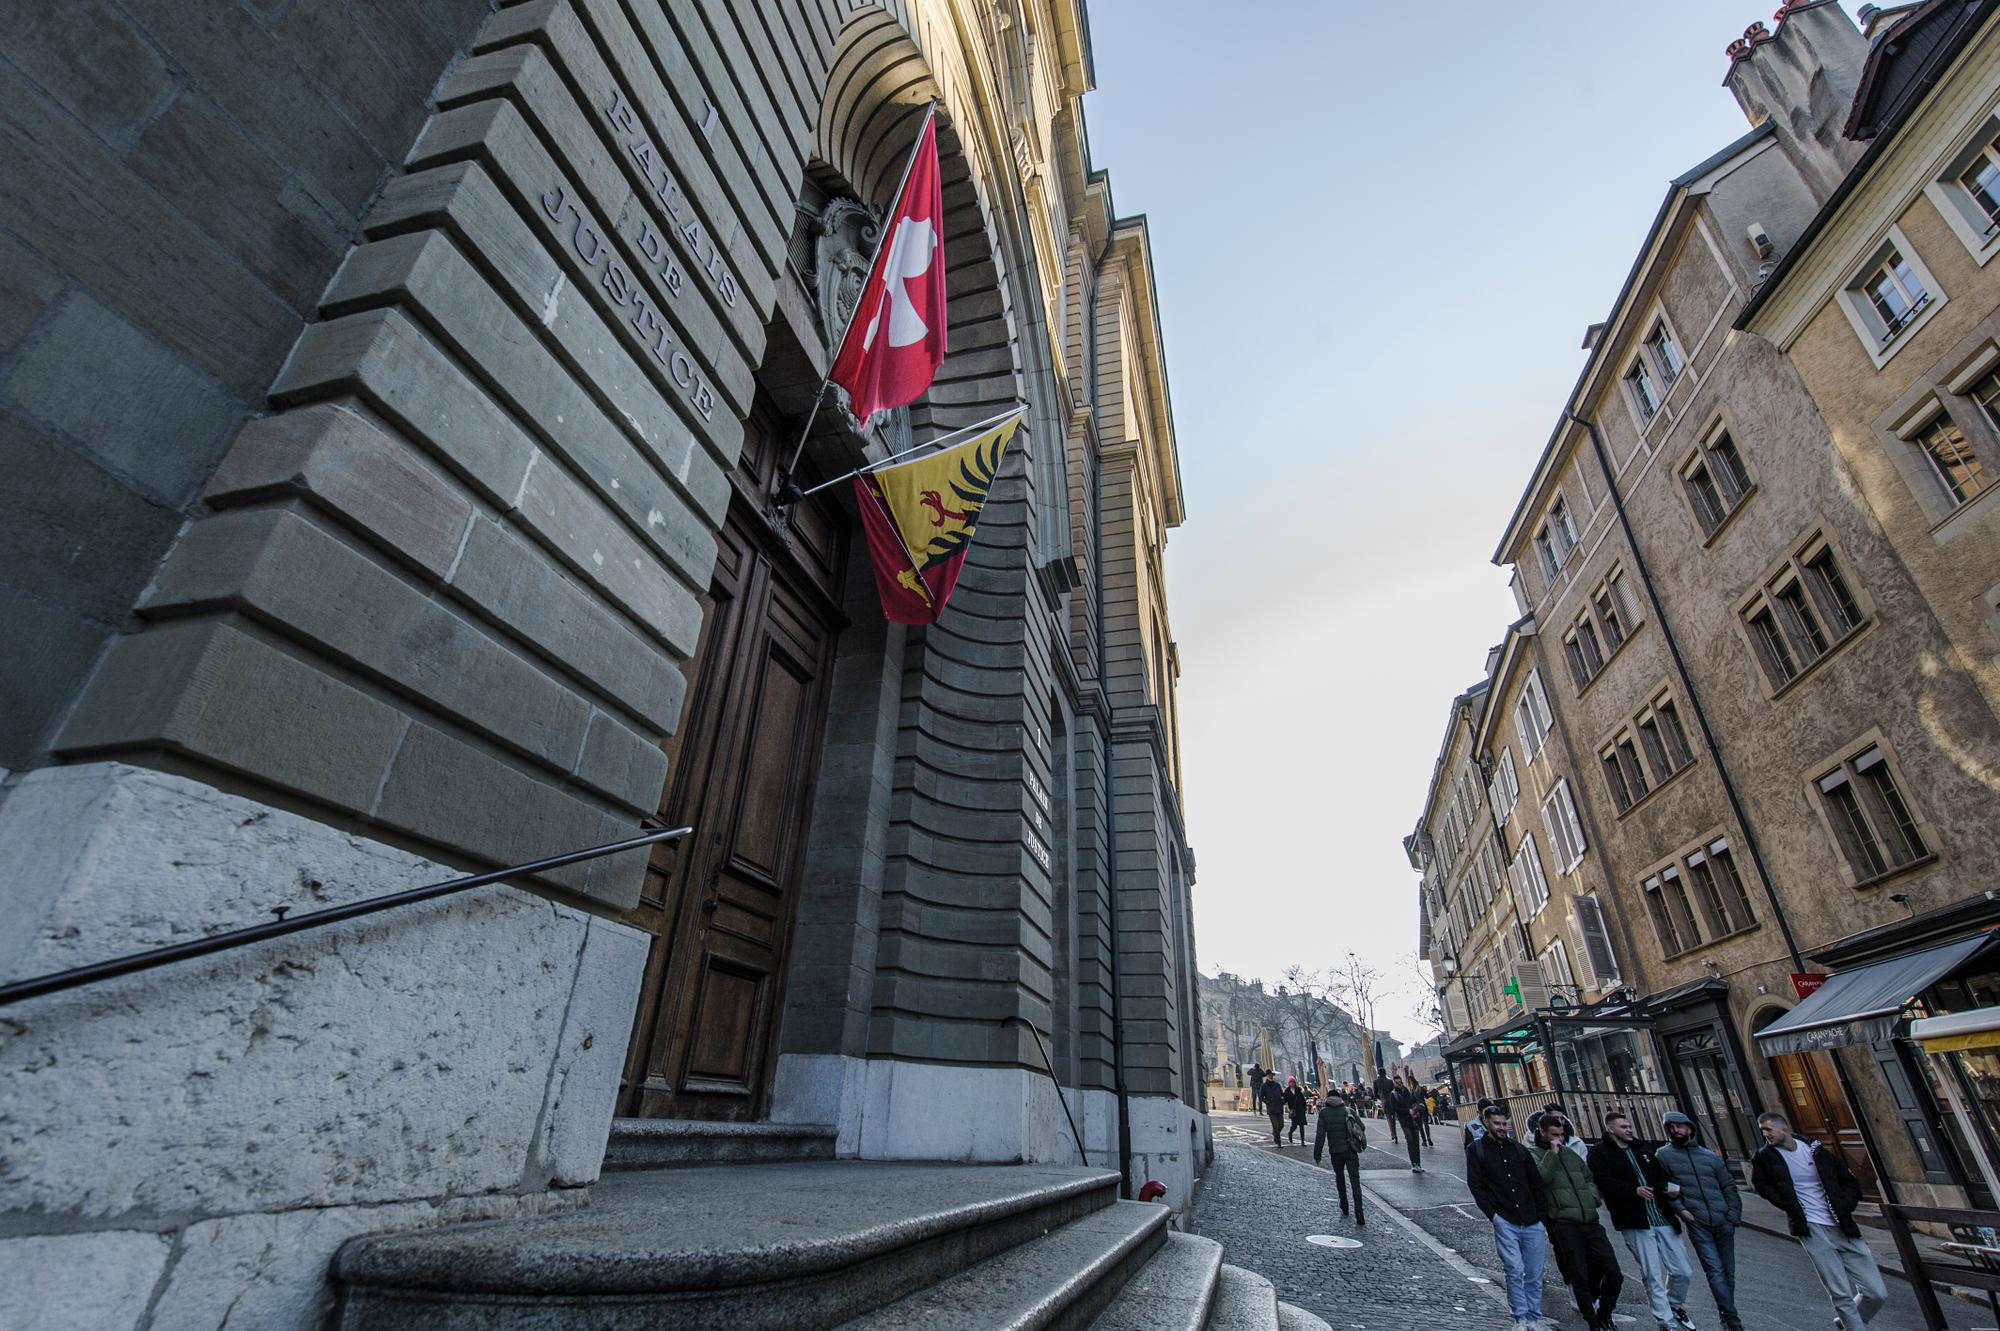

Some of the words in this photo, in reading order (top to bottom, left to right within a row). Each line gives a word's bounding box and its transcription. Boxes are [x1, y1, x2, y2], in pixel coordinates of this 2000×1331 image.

[606, 90, 738, 308] PALAIS
[638, 223, 682, 298] DE
[543, 187, 715, 423] JUSTICE
[1029, 771, 1048, 811] PALAIS
[1027, 830, 1049, 869] JUSTICE
